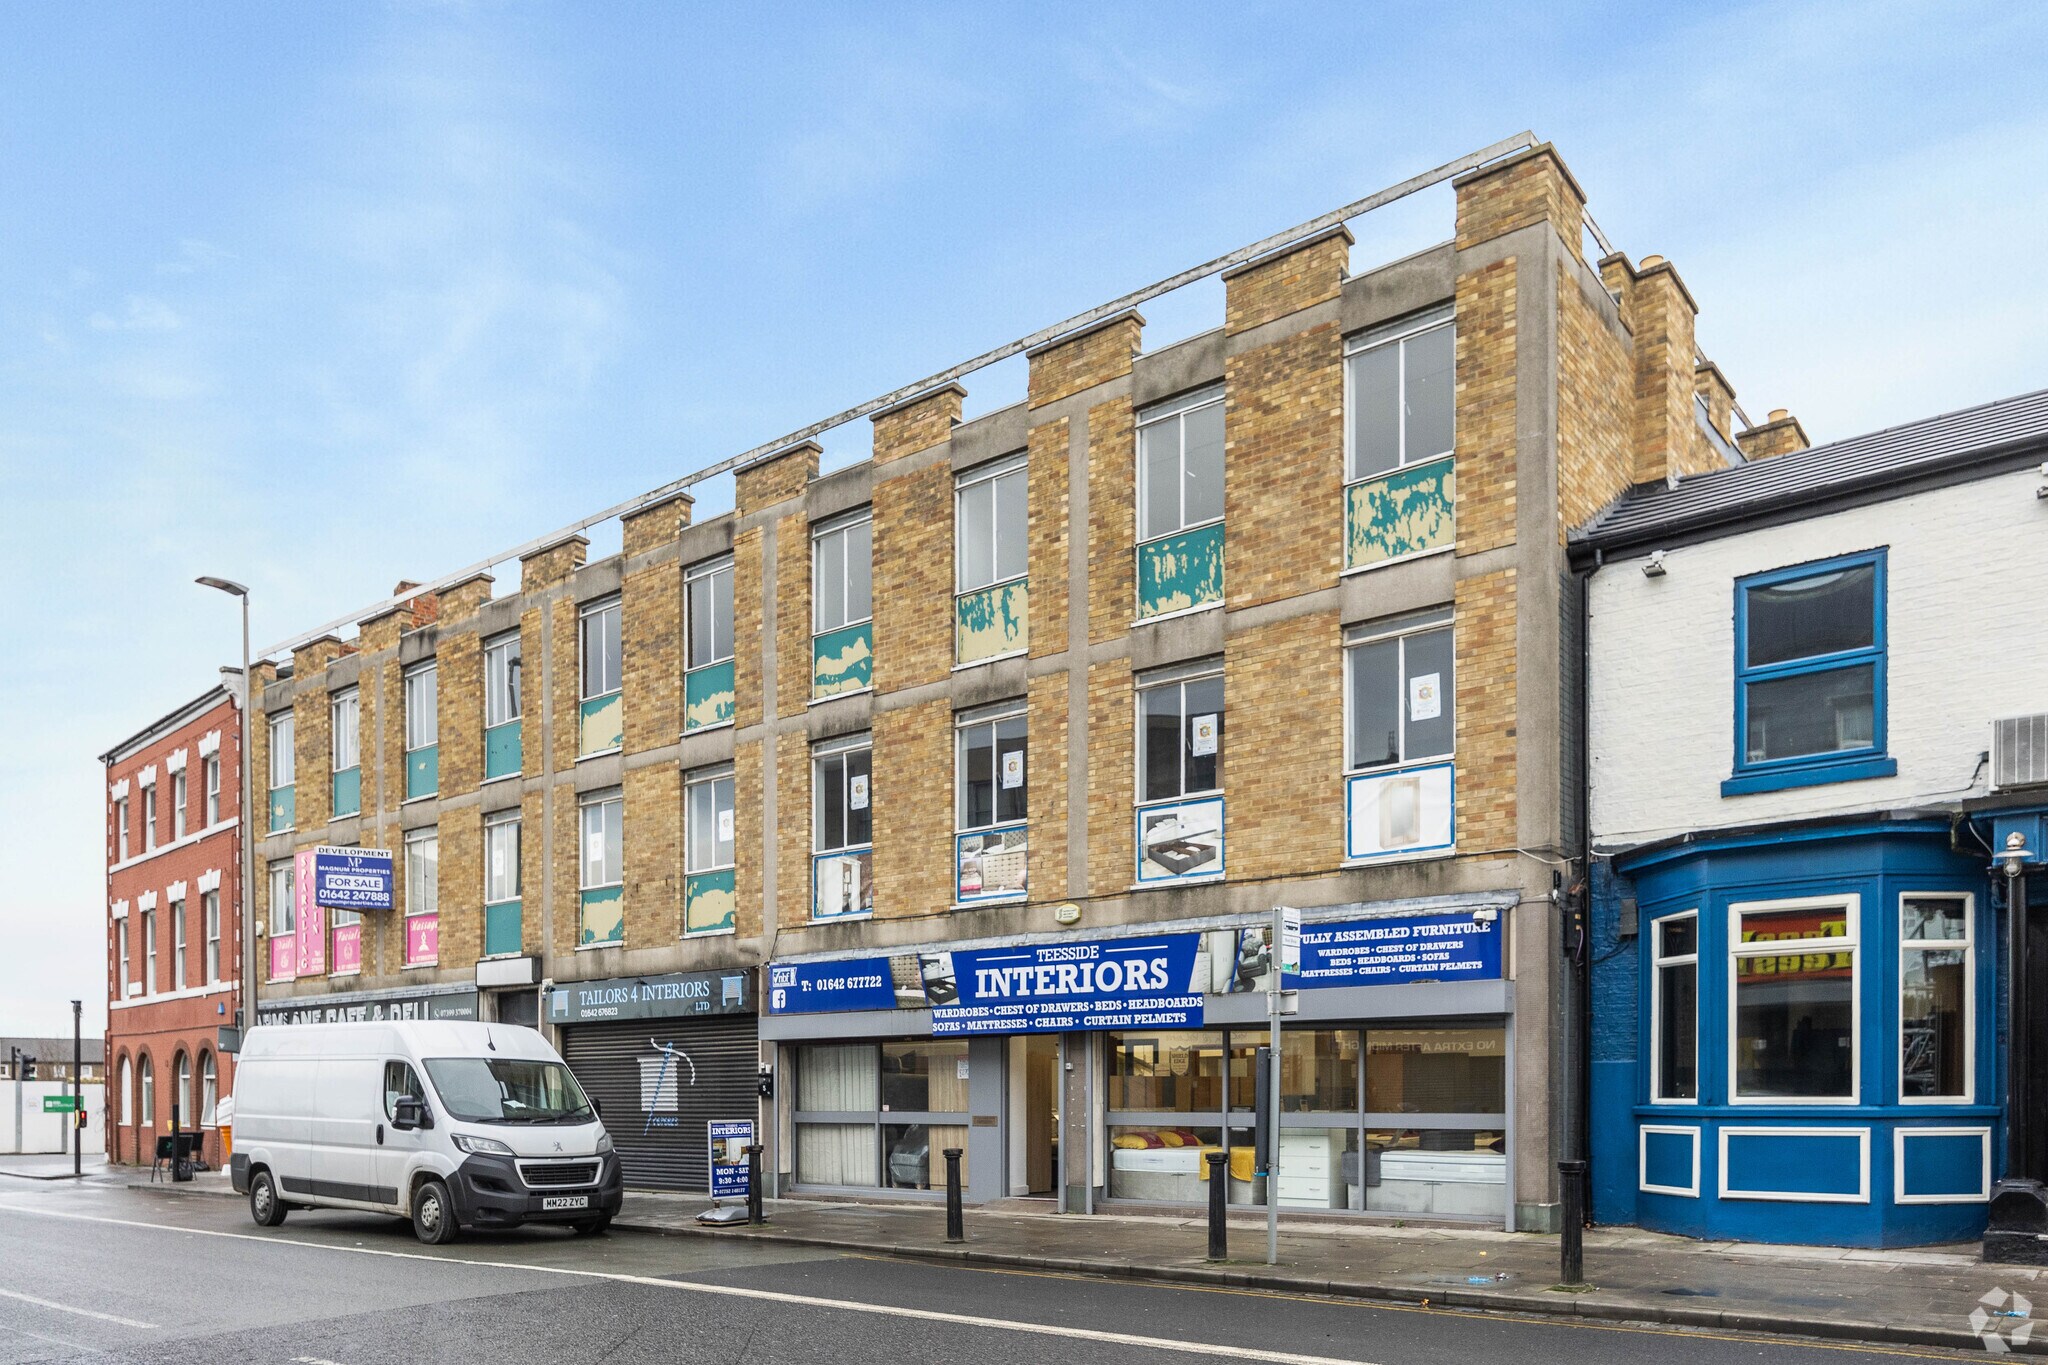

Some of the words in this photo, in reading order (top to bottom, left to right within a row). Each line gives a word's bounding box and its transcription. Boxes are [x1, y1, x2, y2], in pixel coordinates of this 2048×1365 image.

[318, 848, 390, 857] DEVELOPMENT
[328, 878, 351, 887] FOR
[354, 879, 380, 888] SALE
[319, 889, 350, 900] 01642
[352, 891, 390, 901] 247888
[300, 855, 308, 969] SPARKLING
[1300, 932, 1332, 944] ULLY
[1334, 927, 1410, 942] ASSEMBLED
[1413, 922, 1490, 937] FURNITURE
[1037, 945, 1100, 962] TEESSIDE
[1318, 946, 1370, 957] WARDROBES
[1376, 944, 1405, 954] CHEST
[1406, 944, 1418, 952] OF
[1420, 941, 1464, 950] DRAWERS
[1330, 958, 1352, 966] BEDS
[1358, 954, 1416, 964] HEADBOARDS
[1422, 952, 1450, 961] SOFAS
[1301, 968, 1352, 978] MATTRESSES
[1359, 966, 1390, 975] CHAIRS
[1399, 964, 1438, 973] CURTAIN
[1440, 961, 1482, 971] PELMETS
[802, 980, 812, 991] T:
[817, 978, 844, 990] 01642
[847, 976, 882, 988] 677722
[975, 958, 1169, 998] INTERIORS
[580, 988, 628, 1006] TAILORS
[631, 990, 638, 1003] 4
[642, 981, 710, 1000] INTERIORS
[326, 1006, 366, 1023] CAFE
[372, 1004, 384, 1022] &
[696, 1002, 710, 1011] LTD
[933, 1006, 989, 1019] WARDROBES
[994, 1004, 1024, 1016] CHEST
[1026, 1004, 1039, 1014] OF
[1040, 1002, 1089, 1014] DRAWERS
[1095, 1000, 1122, 1012] BEDS
[1128, 996, 1203, 1010] HEADBOARDS
[932, 1022, 960, 1032] SOFAS
[967, 1018, 1028, 1030] MATTRESSES
[1035, 1016, 1073, 1028] CHAIRS
[1084, 1014, 1132, 1026] CURTAIN
[1134, 1013, 1186, 1024] PELMETS
[712, 1127, 751, 1135] INTERIORS
[716, 1168, 734, 1176] MON
[570, 1198, 584, 1206] ZYC
